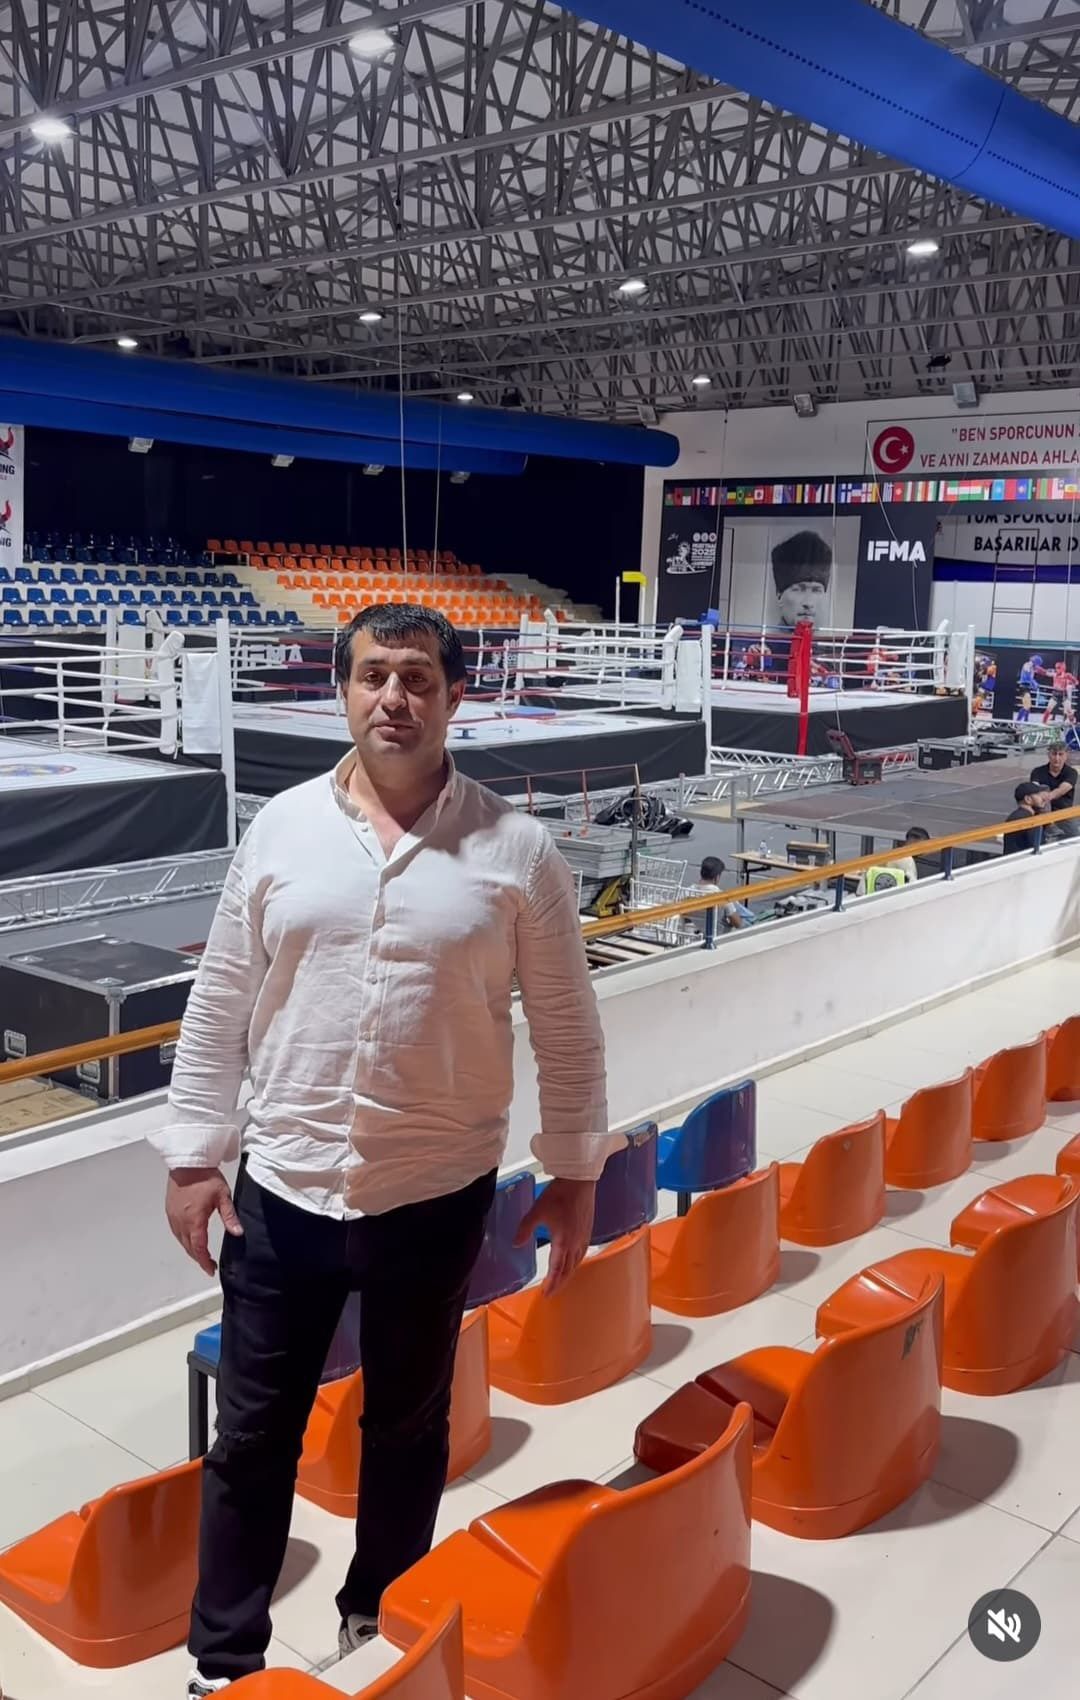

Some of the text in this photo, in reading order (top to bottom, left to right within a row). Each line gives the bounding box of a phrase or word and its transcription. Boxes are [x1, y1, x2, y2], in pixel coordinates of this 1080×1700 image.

[989, 424, 1075, 441] SPORCUNUN
[920, 454, 936, 467] VE
[939, 452, 969, 466] AYNI
[972, 450, 1038, 466] ZAMANDA
[867, 540, 926, 561] IFMA
